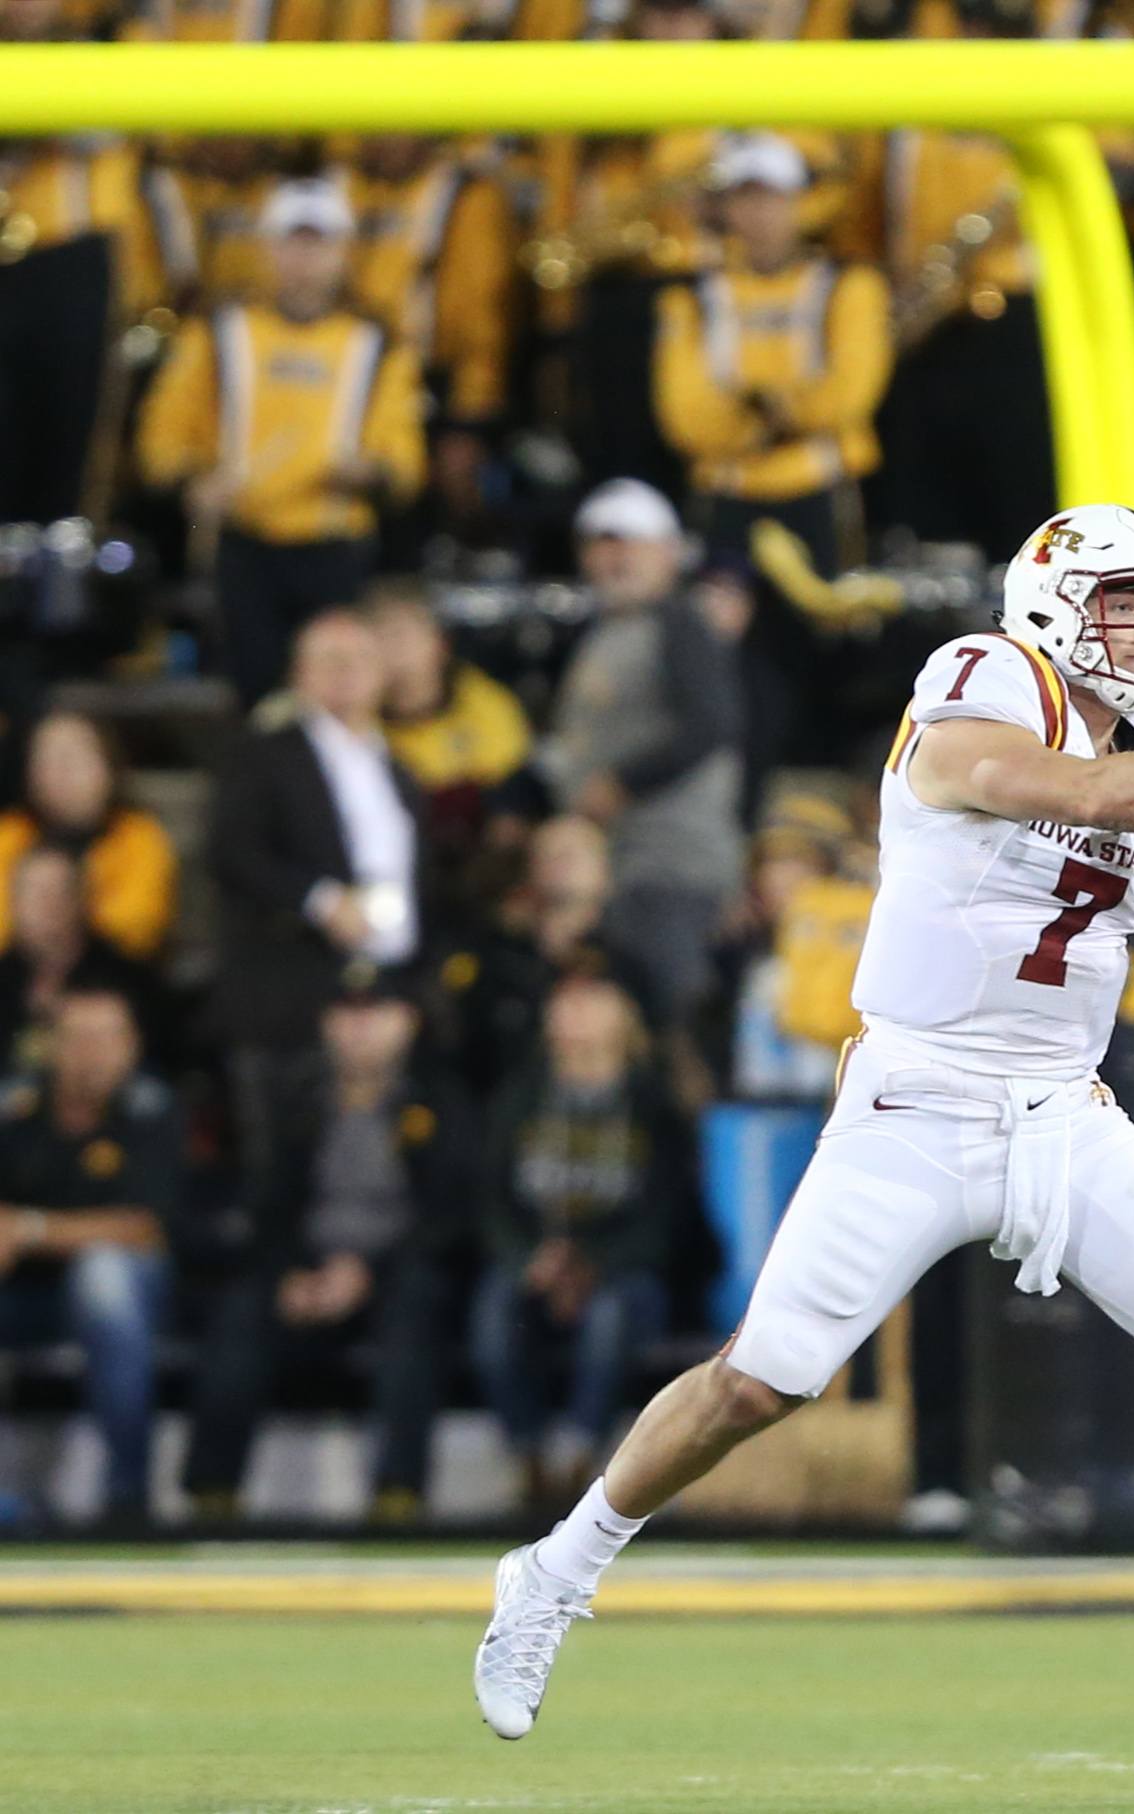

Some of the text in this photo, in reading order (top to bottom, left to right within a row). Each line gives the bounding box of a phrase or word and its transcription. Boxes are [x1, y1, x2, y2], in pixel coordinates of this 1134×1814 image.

[946, 647, 989, 701] 7
[1028, 819, 1094, 858] IOWA
[1015, 857, 1130, 988] 7
